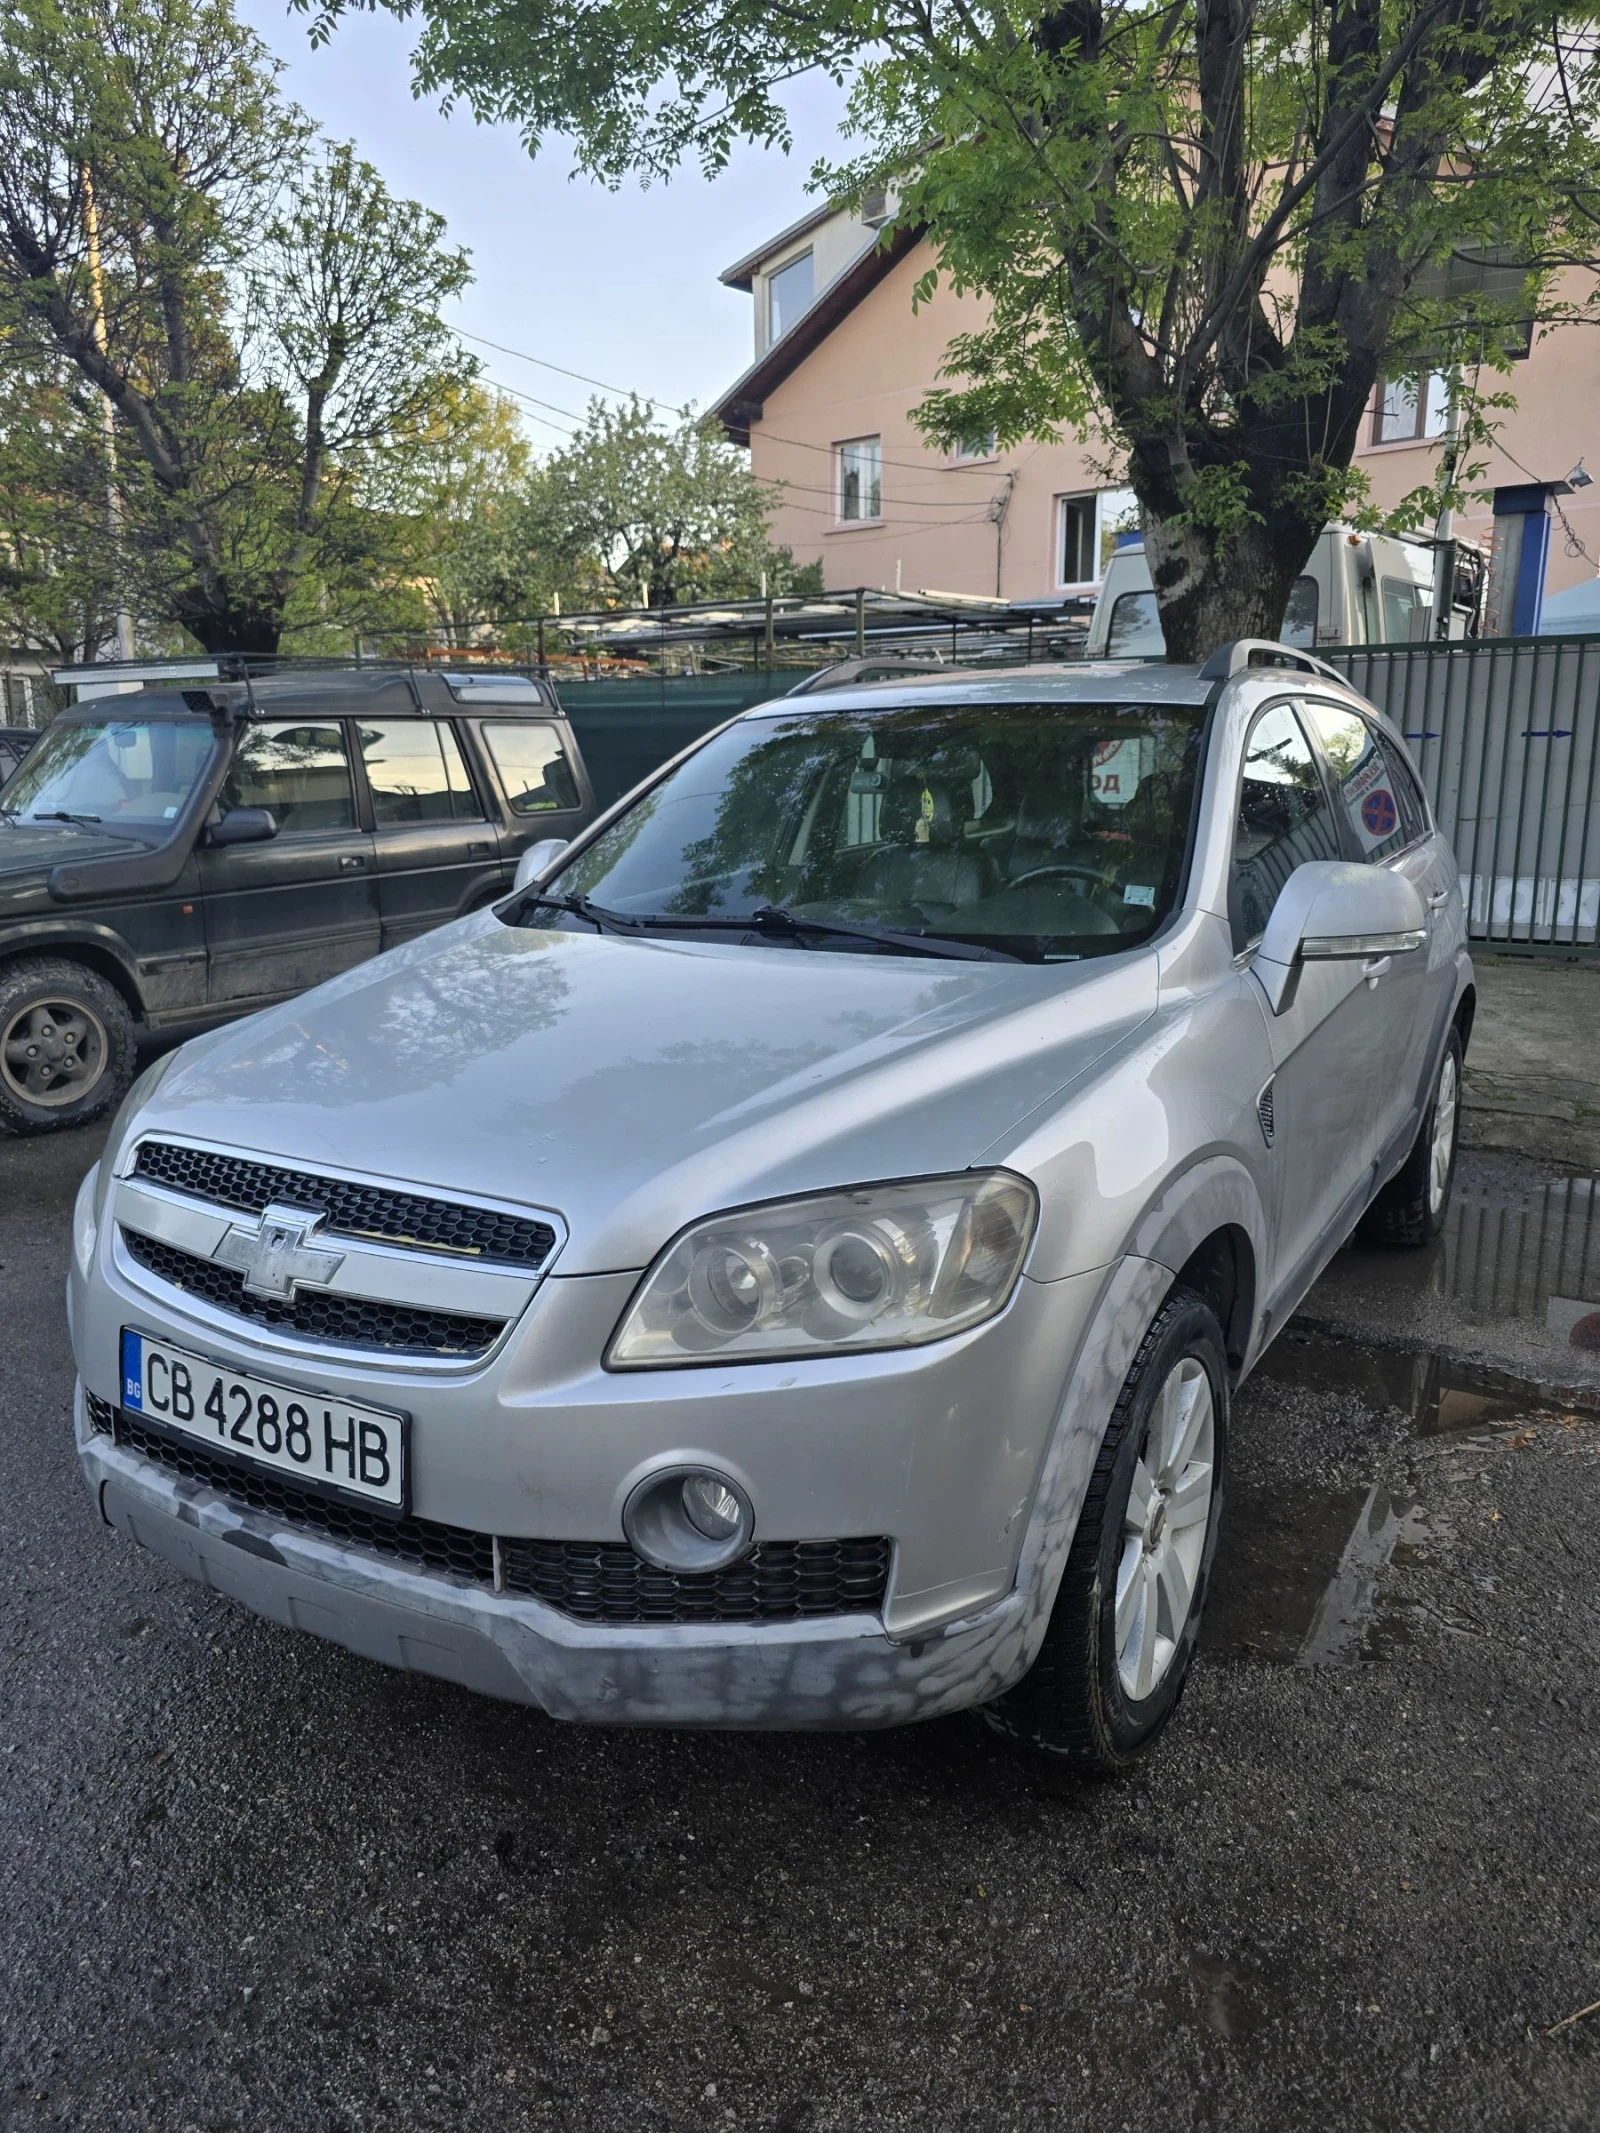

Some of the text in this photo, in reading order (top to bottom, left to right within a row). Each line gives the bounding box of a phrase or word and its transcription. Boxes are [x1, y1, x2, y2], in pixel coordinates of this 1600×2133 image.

[127, 1378, 141, 1399] BG
[147, 1352, 390, 1487] CB 4288 HB
